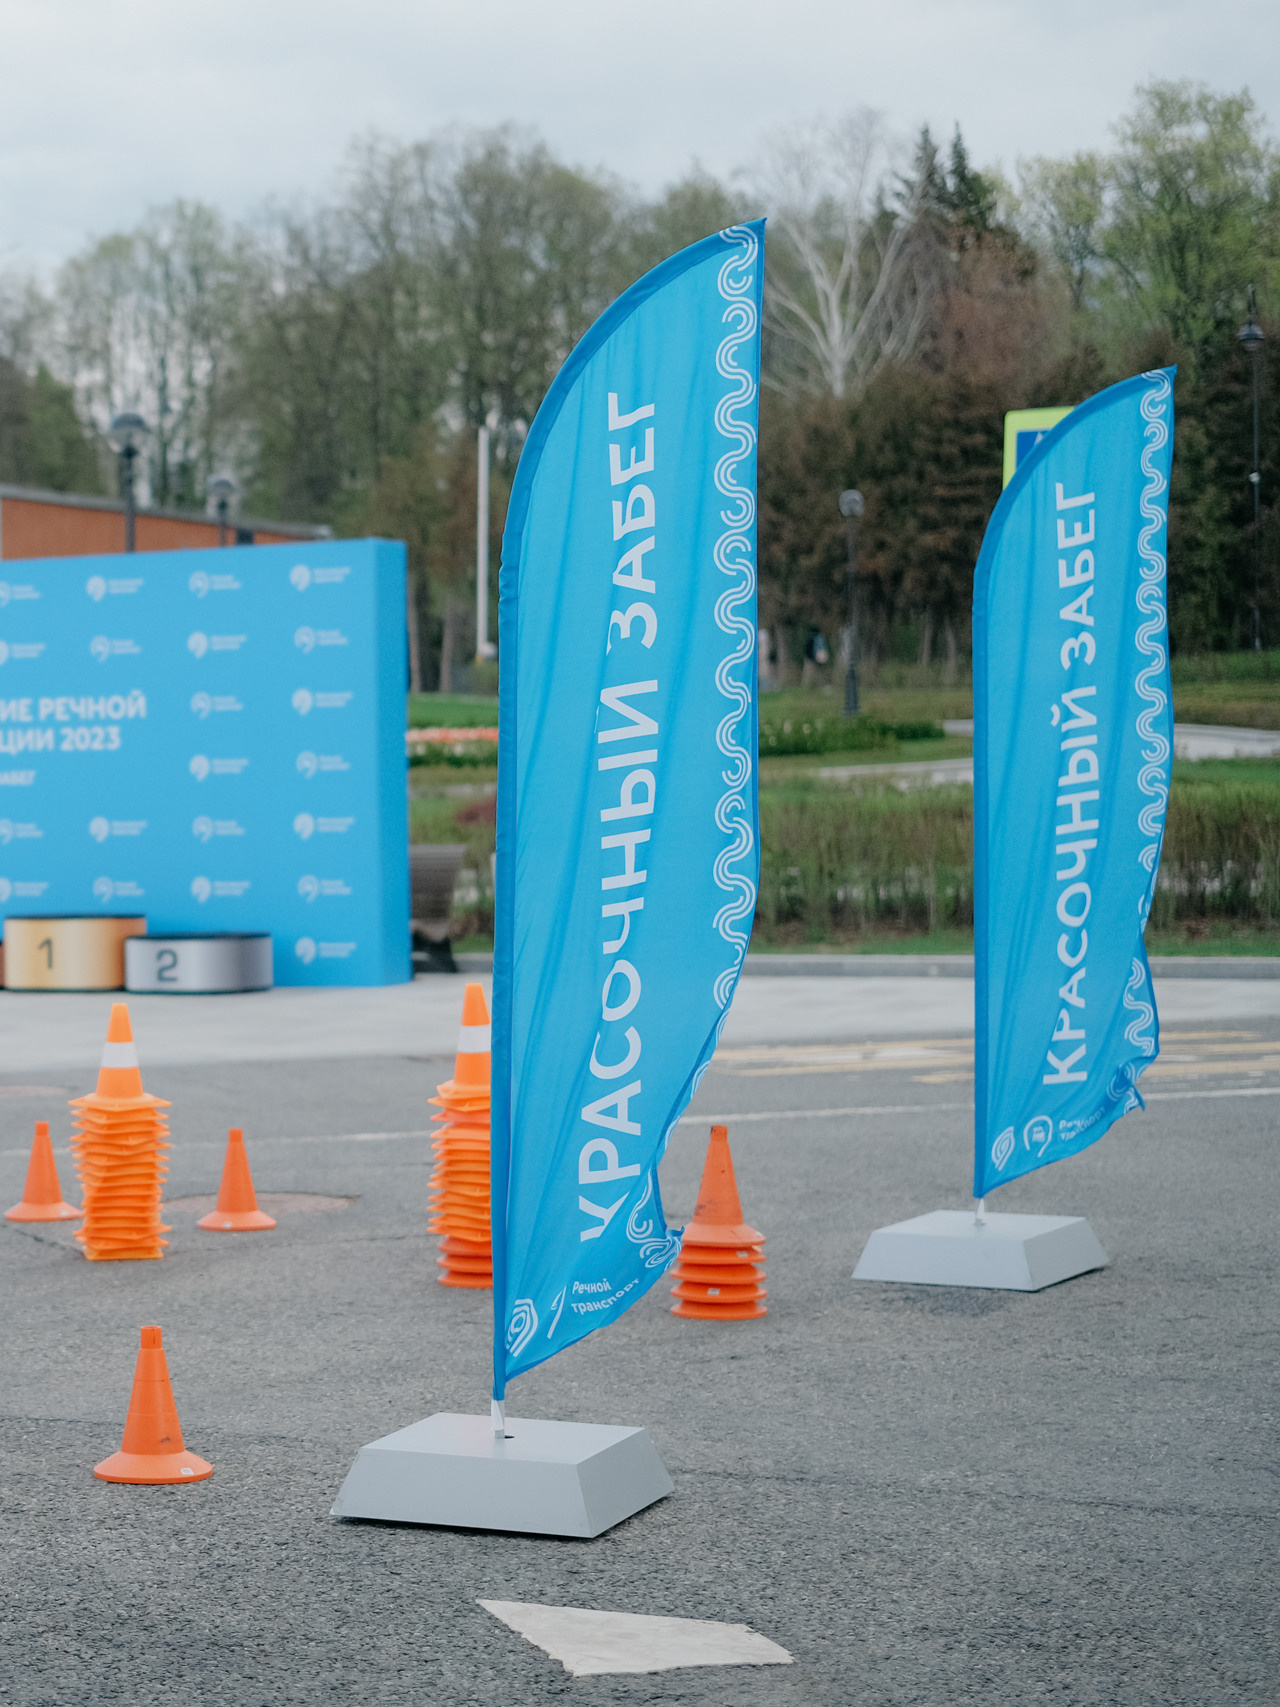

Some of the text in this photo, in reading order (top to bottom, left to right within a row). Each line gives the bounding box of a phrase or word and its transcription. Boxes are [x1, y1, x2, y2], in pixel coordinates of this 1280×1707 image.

[38, 690, 148, 722] РЕЧНОЙ
[60, 726, 122, 751] 2023
[1042, 482, 1101, 1085] КРАСОЧНЫЙ ЗАБЕГ
[578, 392, 658, 1242] КРАСОЧНЫЙ ЗАБЕГ
[37, 938, 55, 970] 1
[155, 949, 179, 982] 2
[570, 1277, 641, 1316] транспорт
[571, 1278, 612, 1295] Речной
